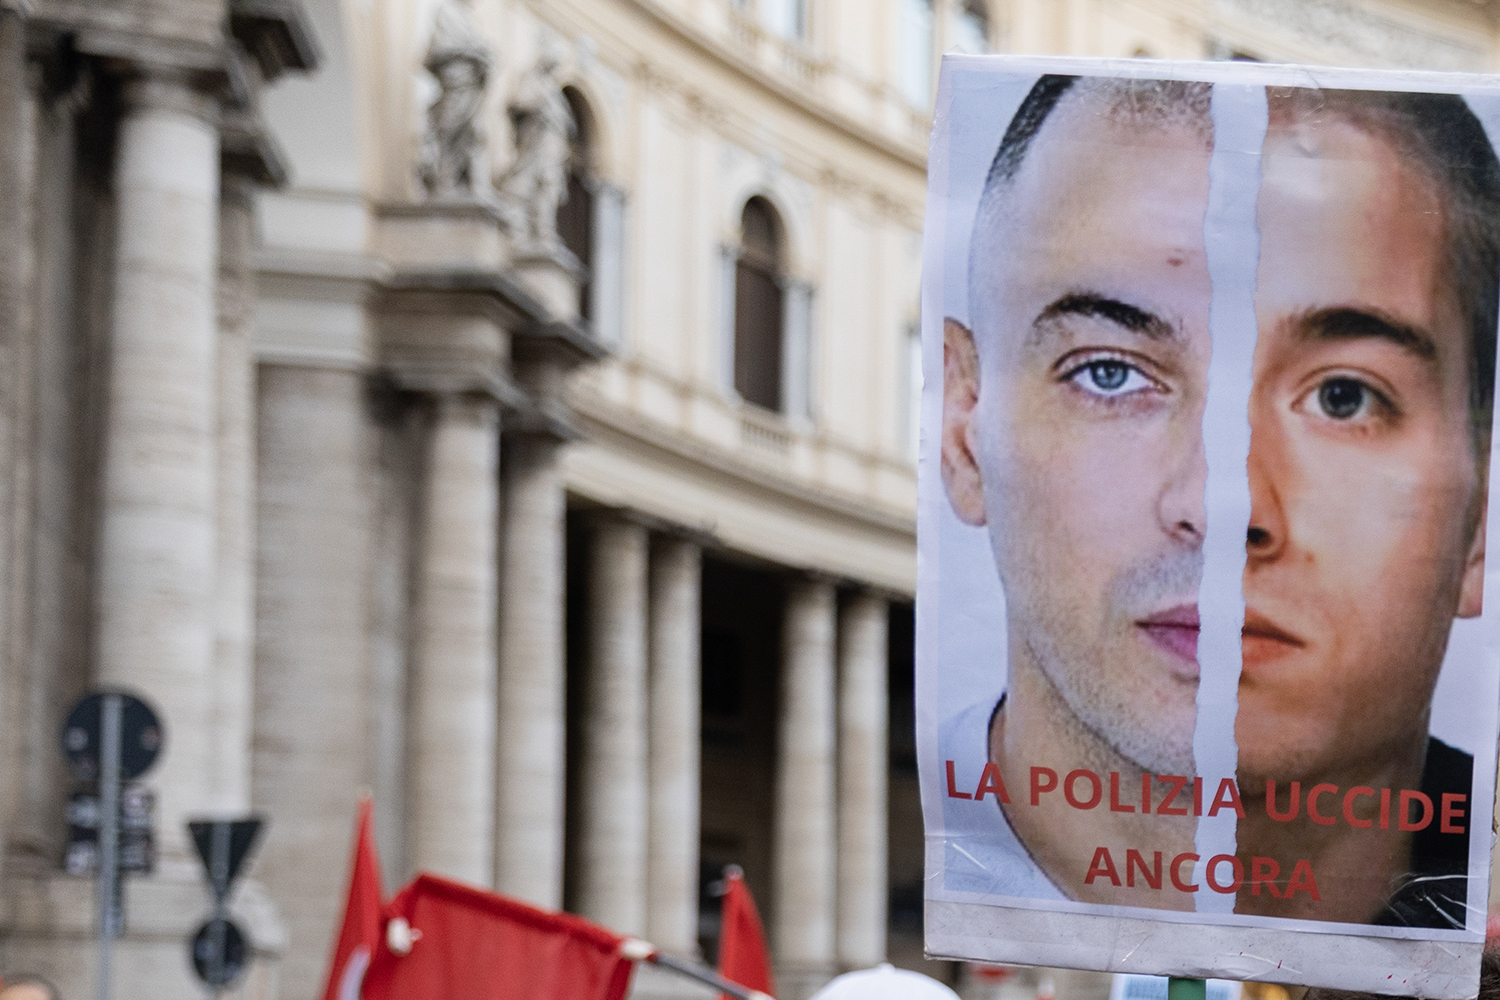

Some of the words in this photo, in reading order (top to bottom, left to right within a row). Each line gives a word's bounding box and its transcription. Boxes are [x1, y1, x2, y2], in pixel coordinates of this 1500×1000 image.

[945, 759, 1011, 804] LA
[1030, 766, 1246, 819] POLIZIA
[1265, 780, 1468, 834] UCCIDE
[1085, 846, 1322, 901] ANCORA
